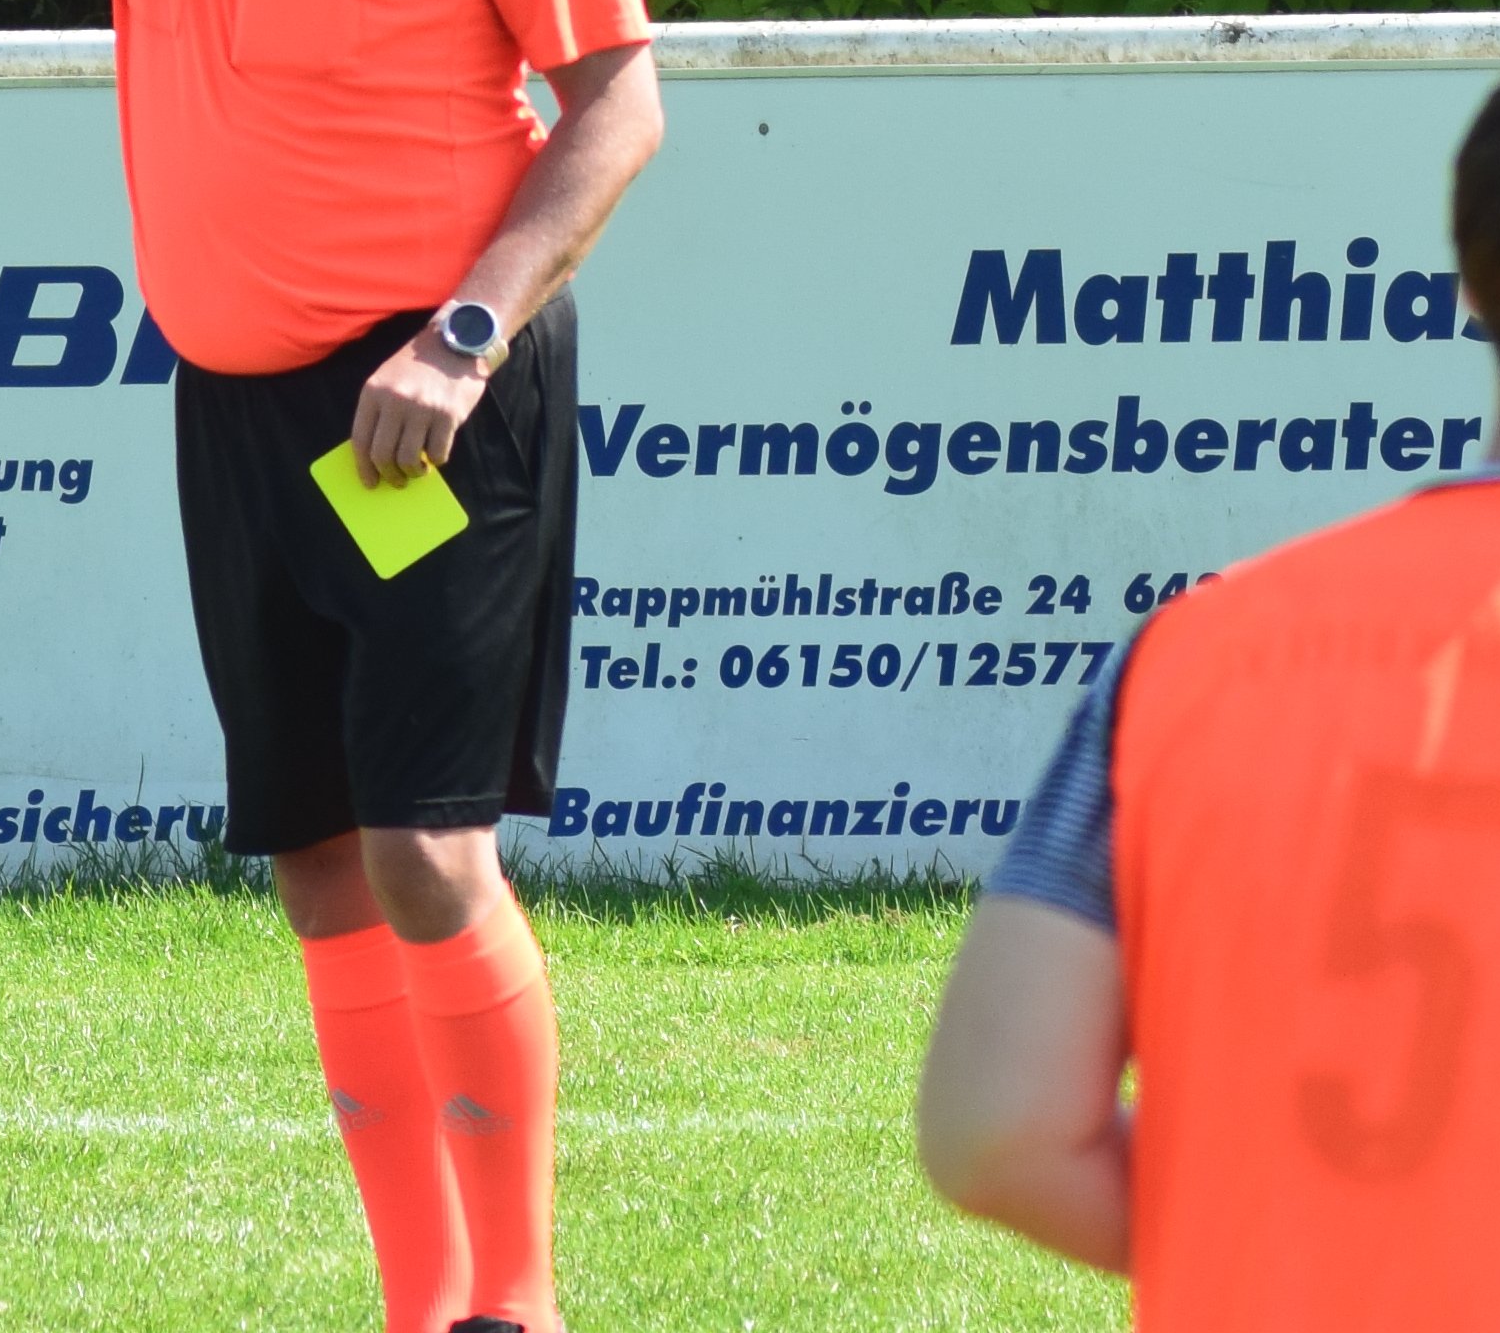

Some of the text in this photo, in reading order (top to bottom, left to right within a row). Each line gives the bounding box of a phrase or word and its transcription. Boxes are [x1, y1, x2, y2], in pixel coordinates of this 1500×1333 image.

[950, 236, 1492, 346] Matthia
[577, 396, 1482, 496] Vermögensberater
[571, 571, 1223, 628] Rappmühlstraße 24 64
[580, 642, 699, 690] Tel.:
